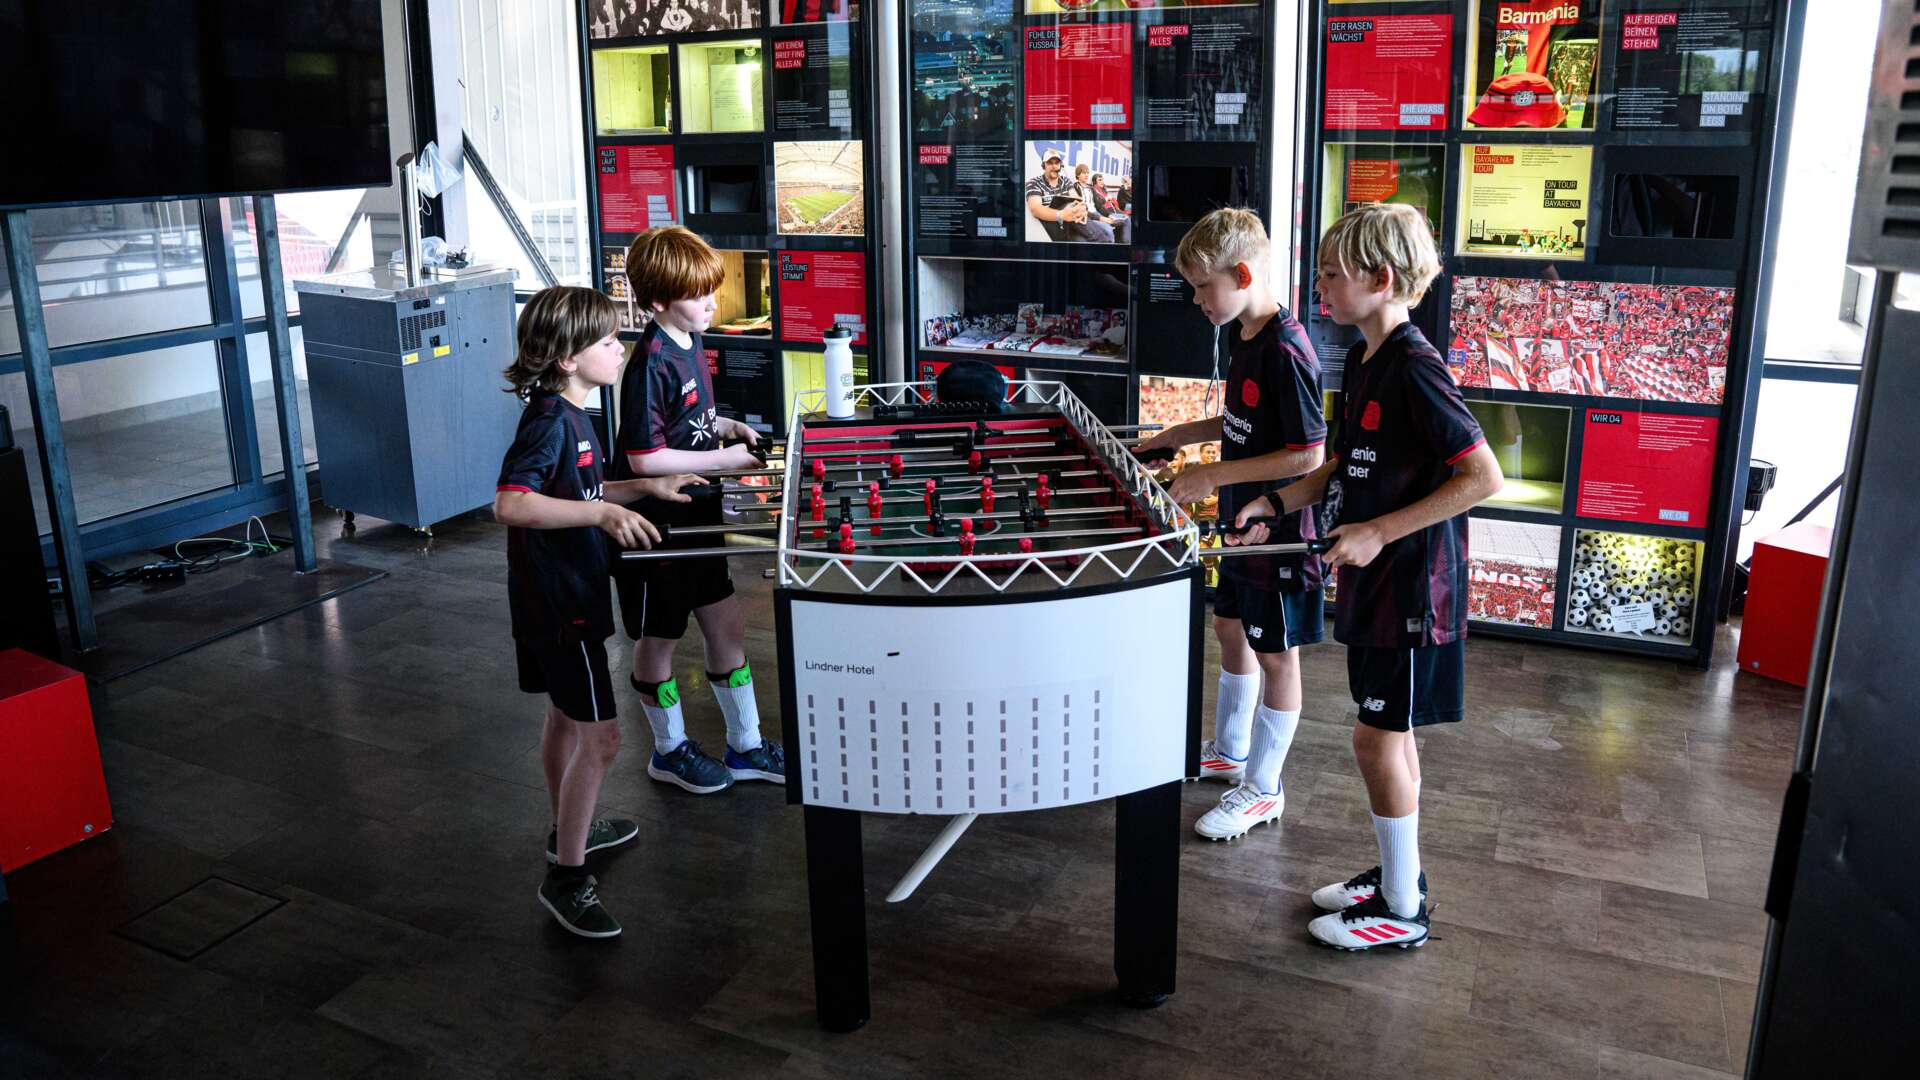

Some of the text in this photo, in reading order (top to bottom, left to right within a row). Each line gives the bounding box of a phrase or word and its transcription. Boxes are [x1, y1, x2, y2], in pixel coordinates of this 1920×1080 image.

[1500, 3, 1579, 24] Barmenia
[1625, 14, 1676, 25] AUF BEIDEN
[1149, 26, 1189, 35] WIR GEBEN
[1331, 21, 1372, 31] DER RASEN
[1028, 31, 1046, 39] FÜHL
[1331, 32, 1363, 42] WÄCHST
[1624, 27, 1657, 37] BEINEN
[1028, 40, 1061, 49] FUSSBALL
[1149, 37, 1172, 46] ALLES
[1623, 39, 1658, 49] STEHEN
[776, 60, 792, 68] ALLES
[1703, 92, 1749, 102] STANDING
[1702, 104, 1742, 115] ON BOTH
[920, 146, 952, 154] EIN GUTER
[920, 156, 948, 164] PARTNER
[1092, 141, 1119, 177] ihn
[1475, 165, 1493, 173] TOUR
[1545, 181, 1577, 189] ON TOUR
[1544, 200, 1579, 208] BAYARENA
[782, 264, 808, 272] LEISTUNG
[1591, 413, 1620, 424] WIR 04
[1351, 446, 1376, 462] enia
[805, 659, 875, 675] Lindner Hotel
